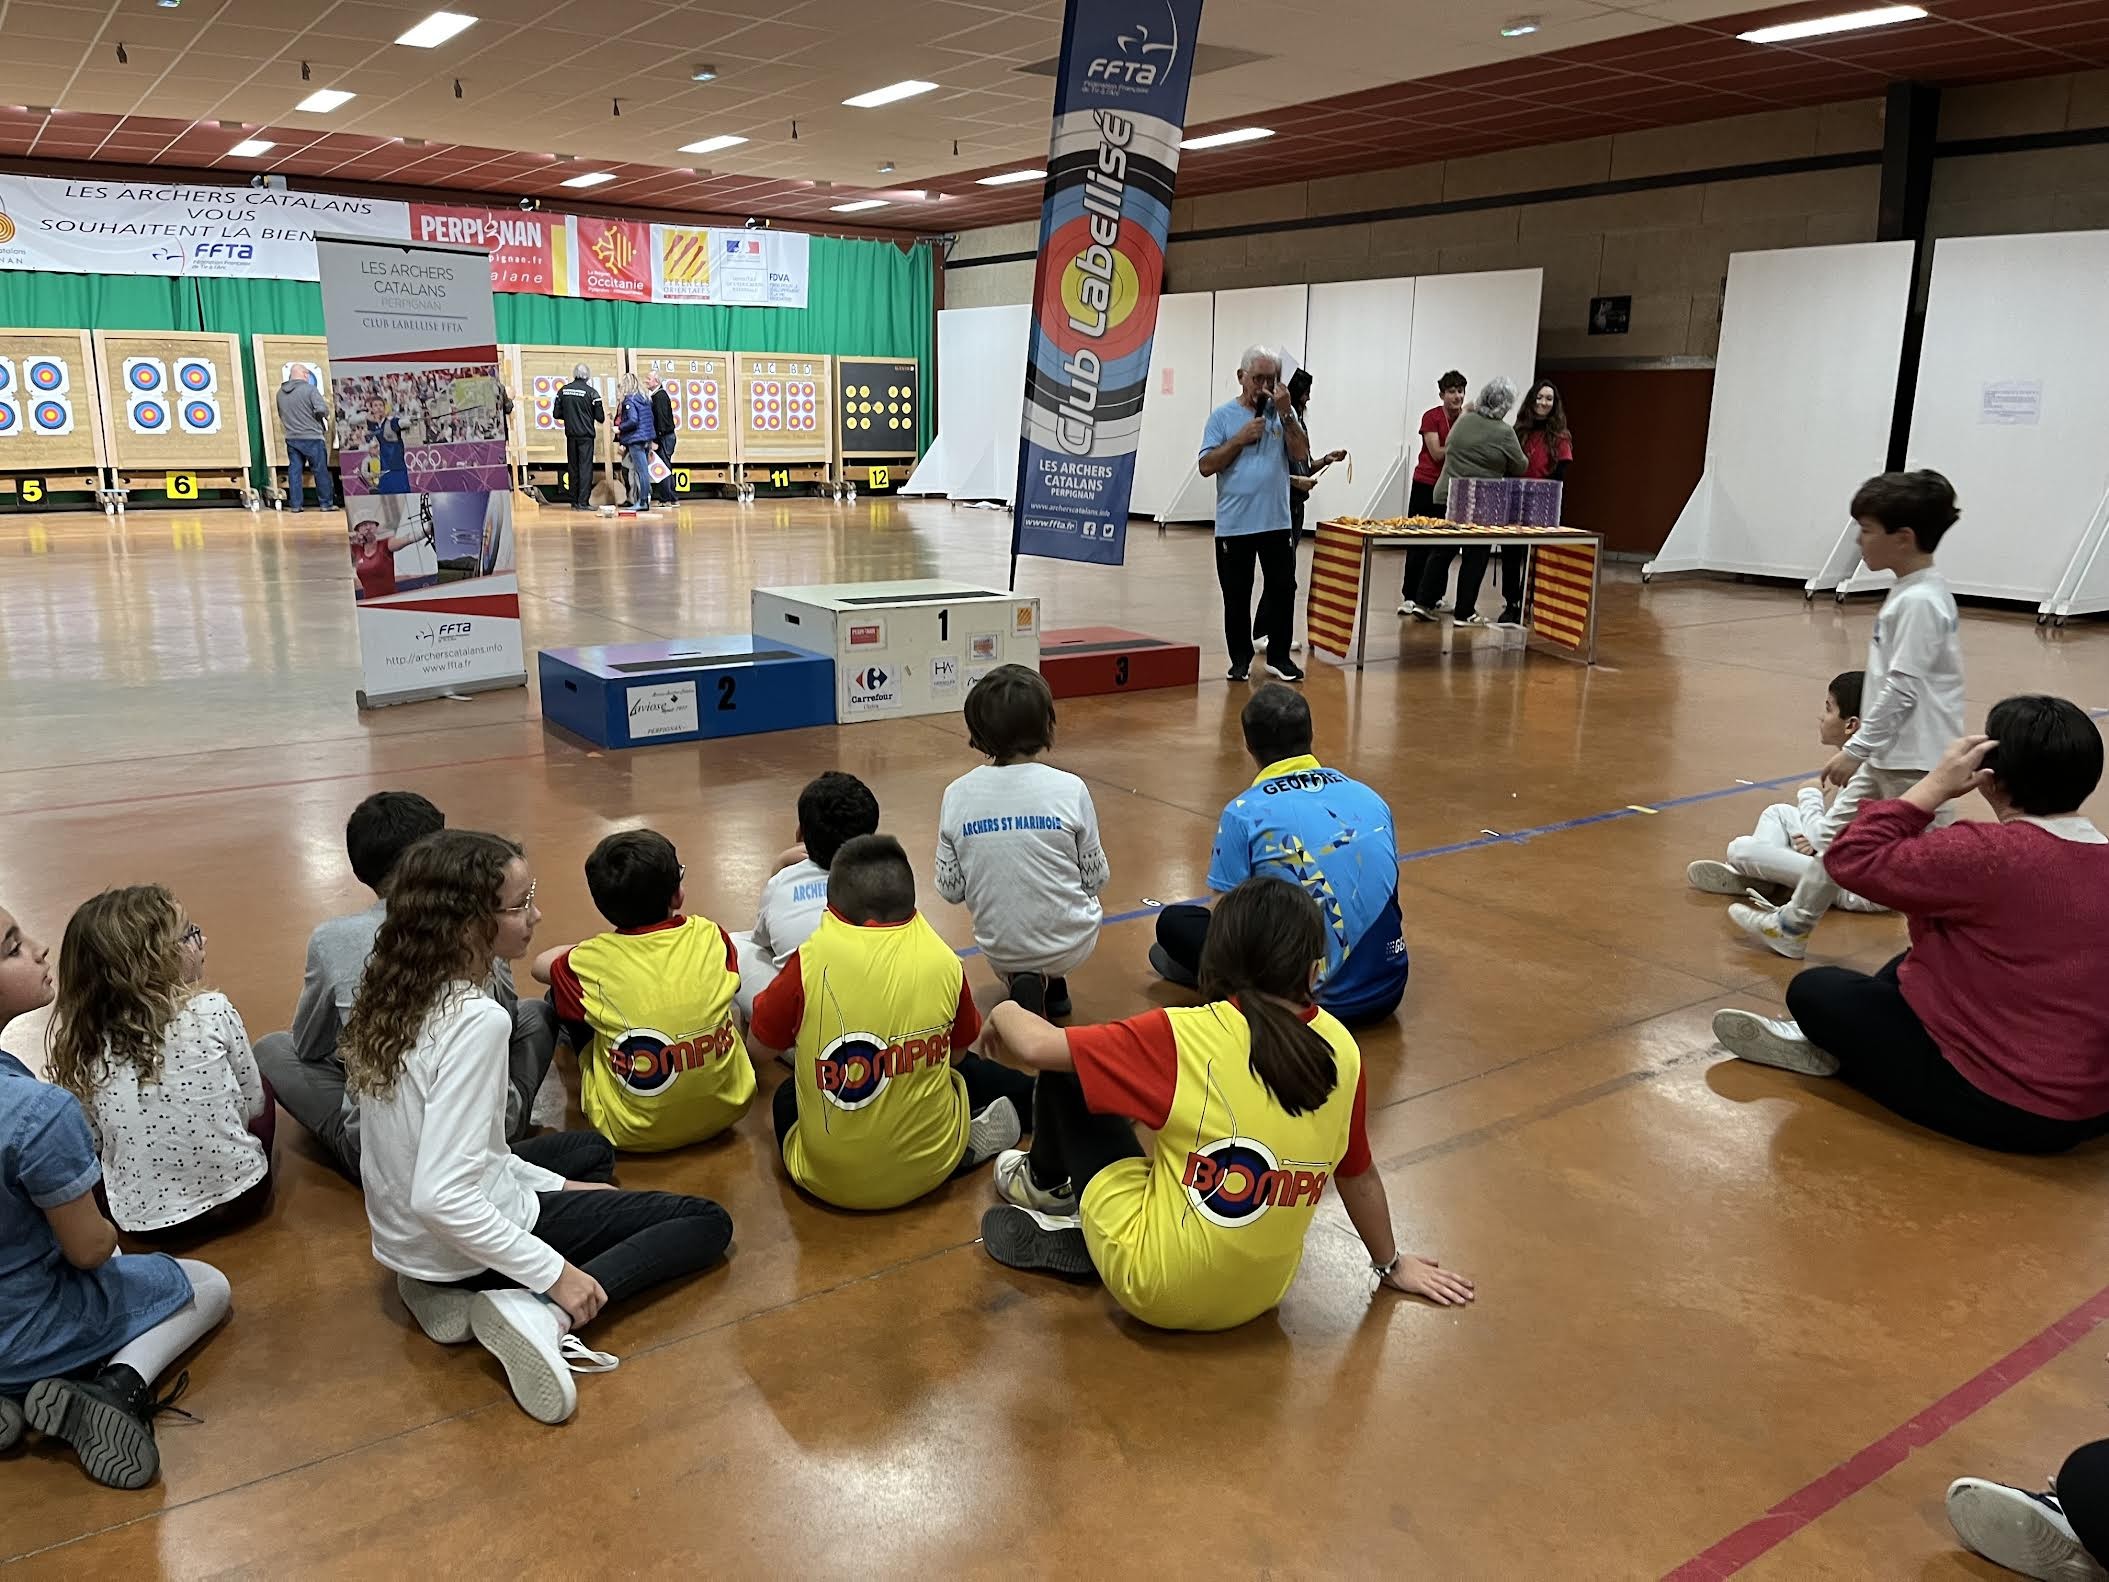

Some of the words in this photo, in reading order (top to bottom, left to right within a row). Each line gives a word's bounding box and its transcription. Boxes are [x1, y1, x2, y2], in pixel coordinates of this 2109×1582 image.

[65, 186, 108, 199] LES
[116, 188, 236, 204] ARCHERS
[246, 193, 372, 214] CATALANS
[187, 208, 256, 221] VOUS
[1068, 107, 1134, 338] Labellisé
[40, 219, 215, 238] SOUHAITENT
[221, 226, 252, 238] LA
[361, 261, 387, 276] LES
[391, 264, 454, 281] ARCHERS
[770, 273, 790, 282] FDVA
[374, 280, 446, 298] CATALANS
[587, 275, 645, 291] Occitanie
[381, 297, 442, 312] PERPIGNAN
[362, 318, 389, 329] CLUB
[652, 360, 660, 370] A
[666, 360, 674, 371] C
[690, 361, 697, 372] B
[754, 363, 761, 373] A
[769, 363, 775, 374] C
[791, 364, 797, 374] B
[1055, 347, 1101, 456] Club
[1040, 458, 1057, 473] LES
[1060, 460, 1113, 478] ARCHERS
[173, 475, 192, 494] 6
[674, 471, 688, 488] 10
[771, 469, 789, 488] 11
[872, 469, 887, 486] 12
[1044, 474, 1104, 492] CATALANS
[22, 480, 43, 501] 5
[1050, 487, 1096, 501] PERPIGNAN
[937, 609, 949, 641] 1
[1115, 655, 1129, 687] 3
[717, 675, 737, 711] 2
[851, 693, 894, 704] Carrefour
[962, 817, 999, 838] ARCHERS
[1001, 816, 1013, 831] ST
[1181, 1151, 1329, 1208] BOMPA
